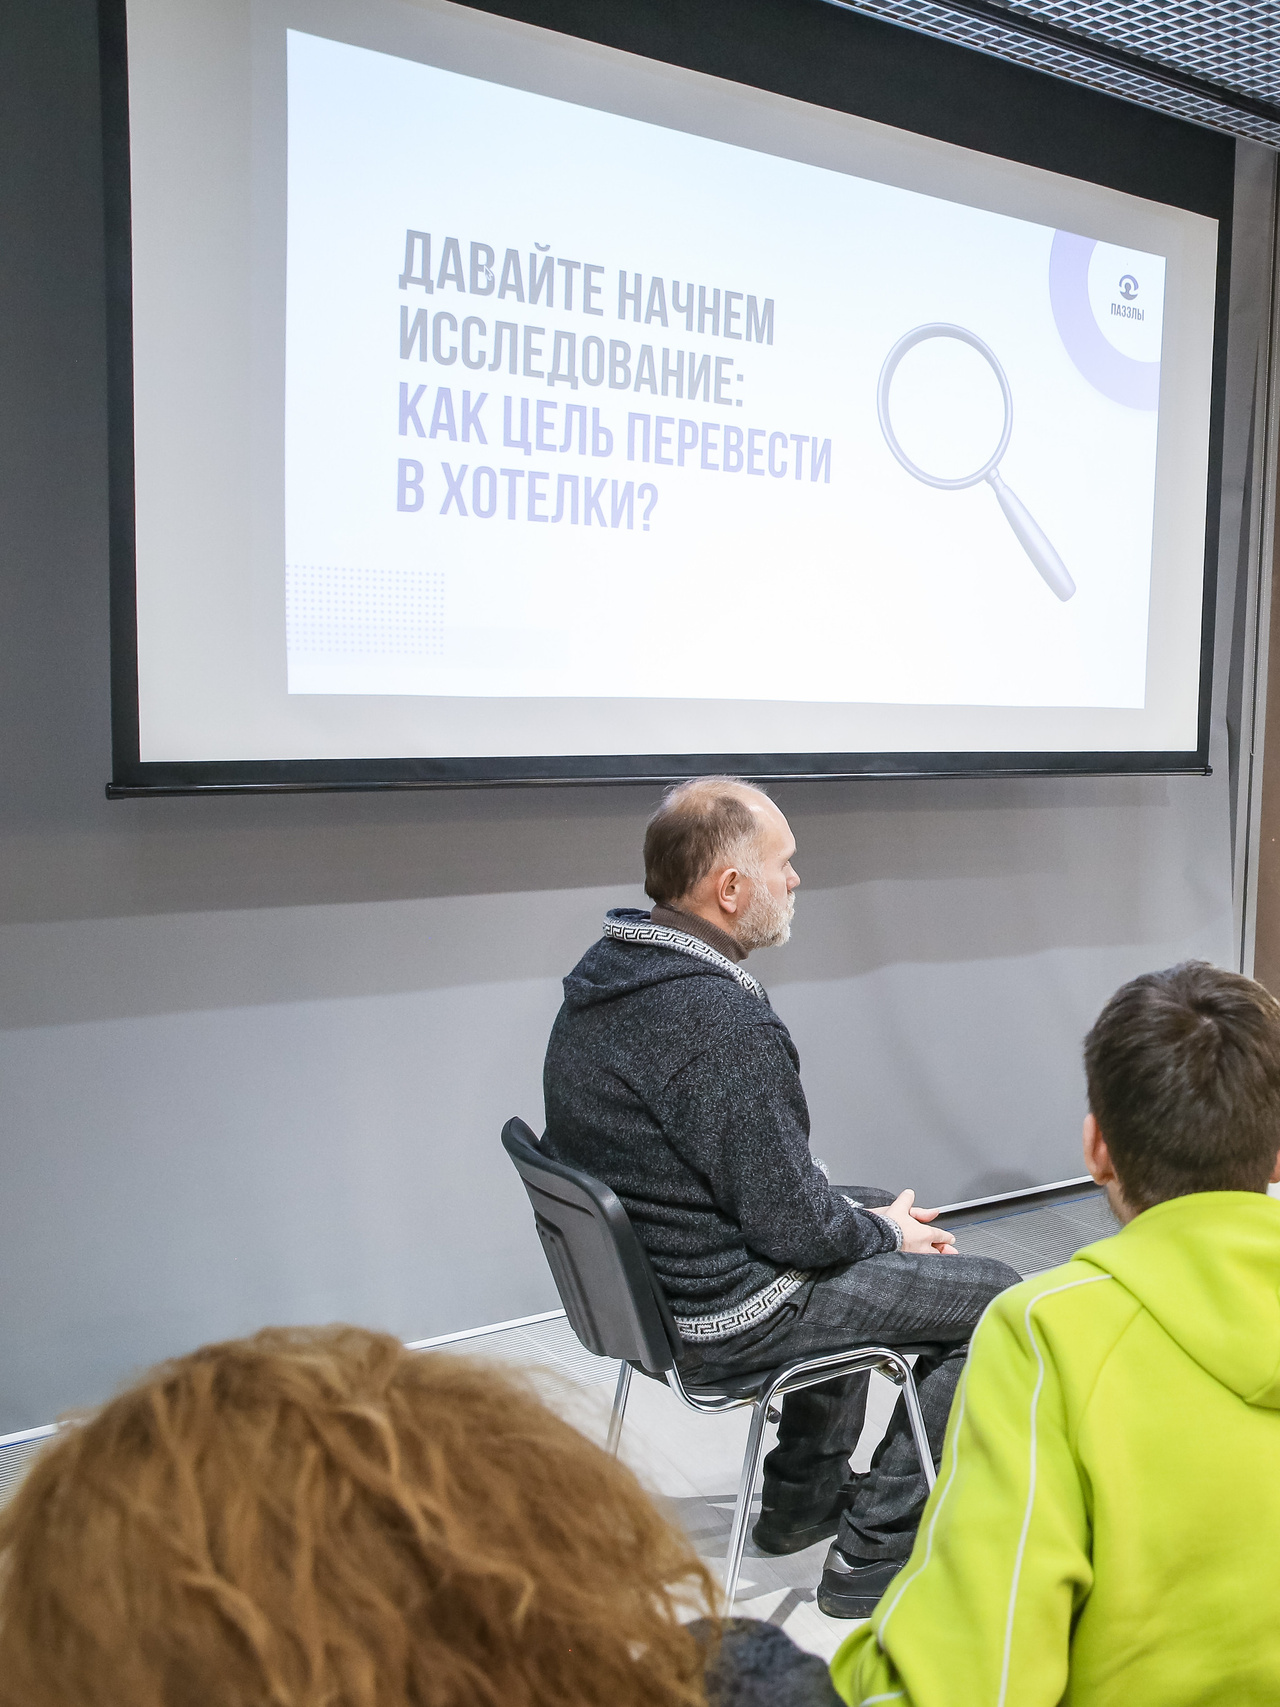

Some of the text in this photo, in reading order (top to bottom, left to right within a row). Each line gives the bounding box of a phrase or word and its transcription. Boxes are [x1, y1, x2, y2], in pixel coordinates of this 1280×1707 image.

[399, 229, 775, 345] ДАВАЙТЕ НАЧНЕМ
[1110, 303, 1145, 321] ПАЗЗЛЫ
[400, 305, 744, 407] ИССЛЕДОВАНИЕ:
[398, 382, 832, 484] КАК ЦЕЛЬ ПЕРЕВЕСТИ
[397, 458, 659, 531] В ХОТЕЛКИ?
